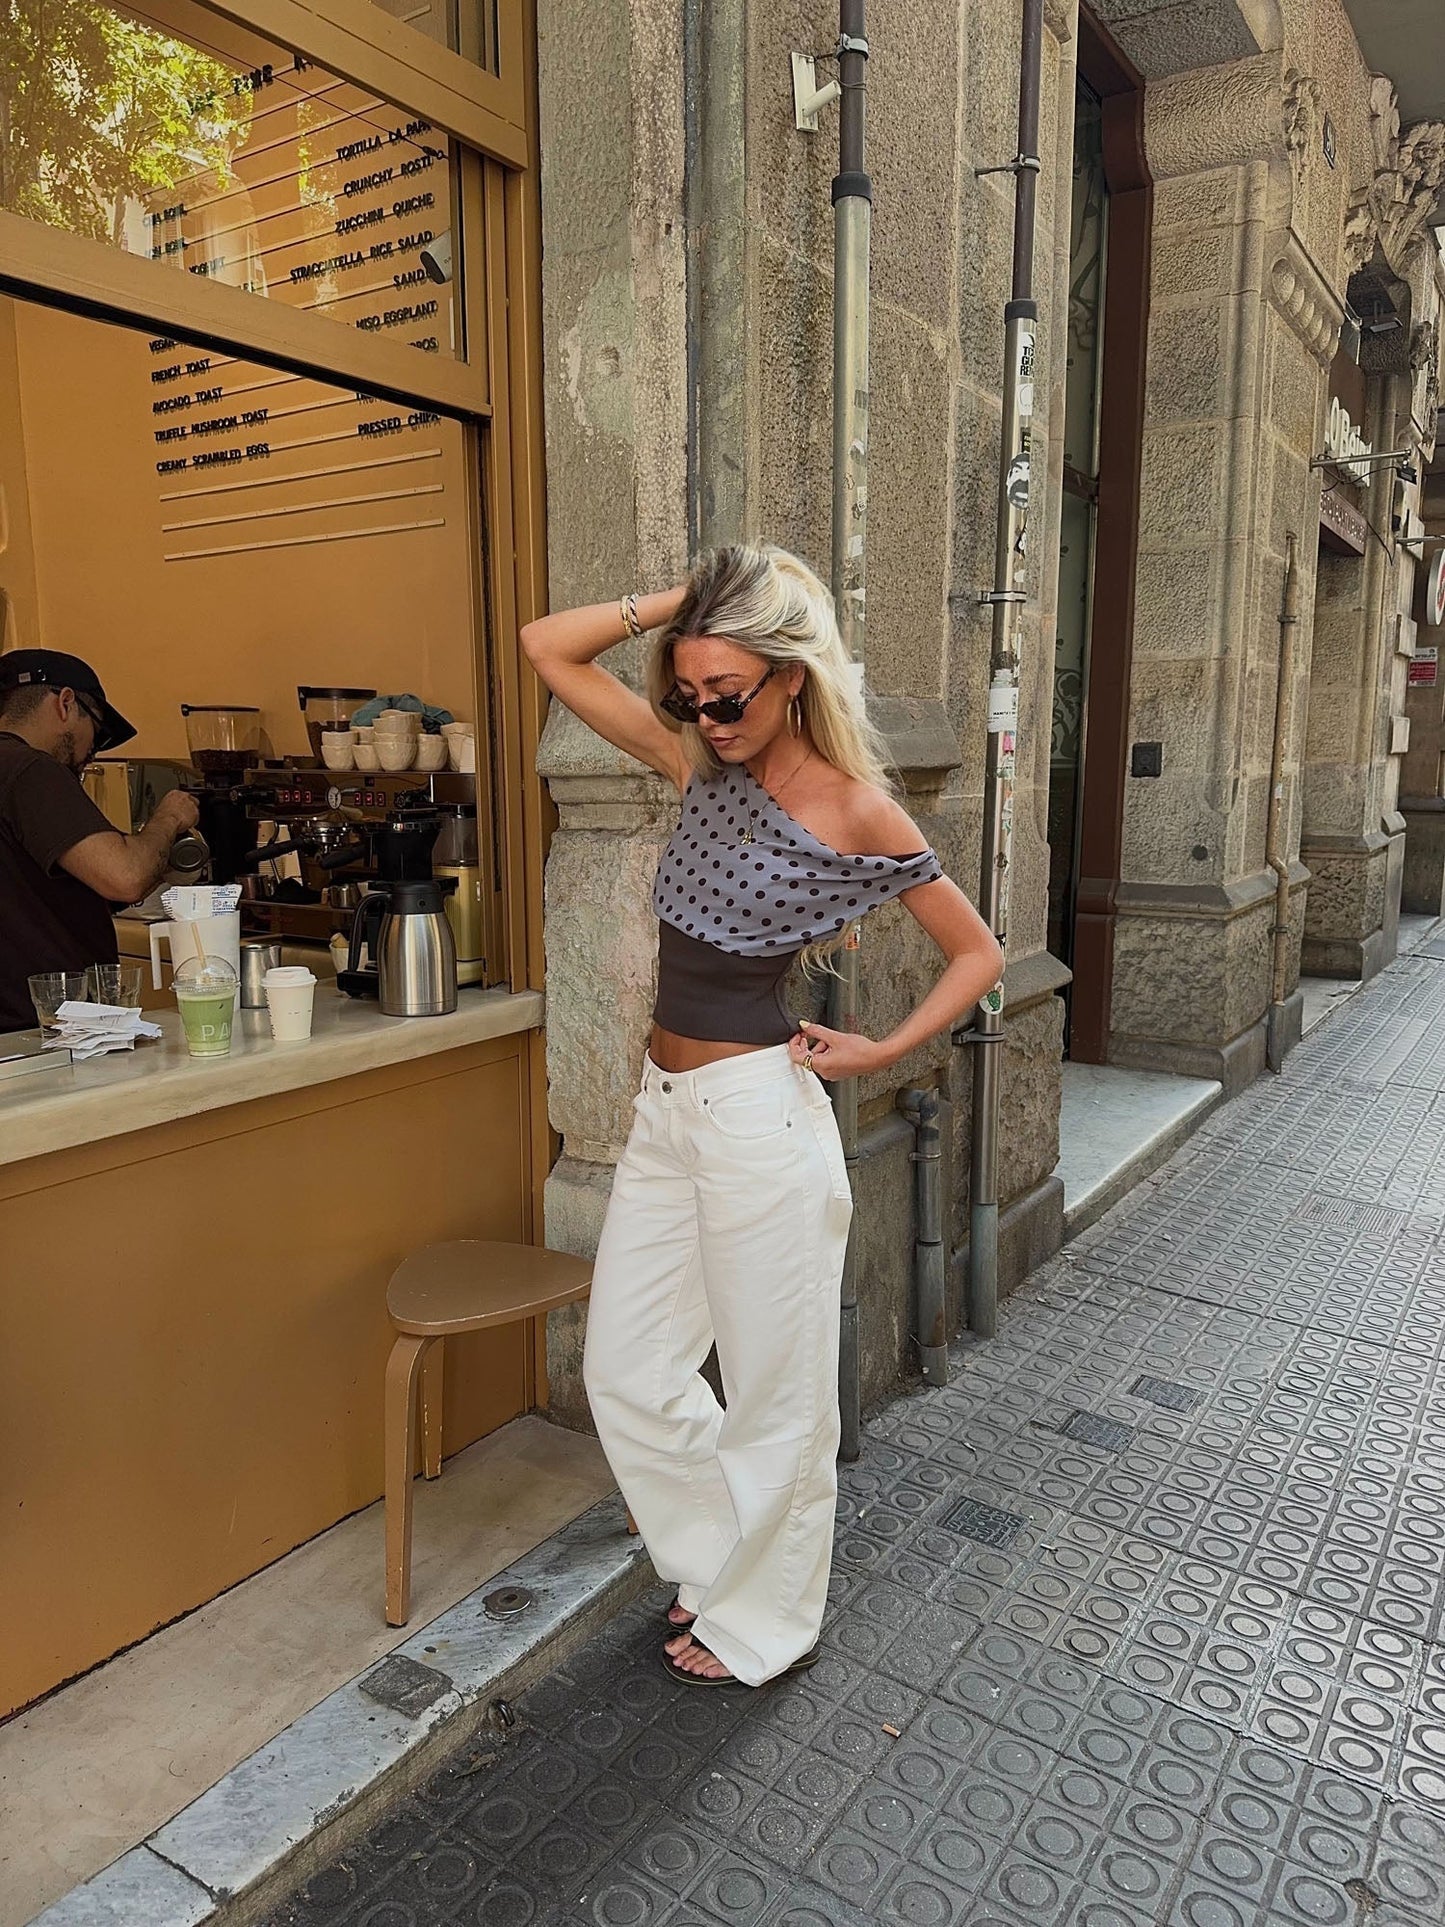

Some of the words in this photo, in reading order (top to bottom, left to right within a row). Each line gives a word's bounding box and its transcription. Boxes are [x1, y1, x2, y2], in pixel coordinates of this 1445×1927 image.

[336, 135, 383, 159] TORTILLA
[343, 168, 393, 194] CRUNCHY
[335, 208, 384, 232] ZUCCHINI
[393, 193, 433, 216] QUICHE
[290, 251, 363, 281] STRACCIATELLA
[370, 242, 392, 257] RICE
[398, 231, 433, 249] SALAD
[384, 300, 437, 324] EGGPLANT
[151, 365, 181, 382] FRENCH
[185, 358, 210, 373] TOAST
[152, 395, 190, 412] AVOCADO
[195, 387, 223, 402] TOAST
[154, 426, 187, 441] TRUFFLE
[191, 416, 237, 433] MUSHROOM
[241, 409, 268, 424] TOAST
[358, 417, 401, 435] PRESSED
[156, 458, 187, 472] CREAMY
[192, 449, 241, 464] SCRAMBLED
[246, 443, 269, 457] EGGS
